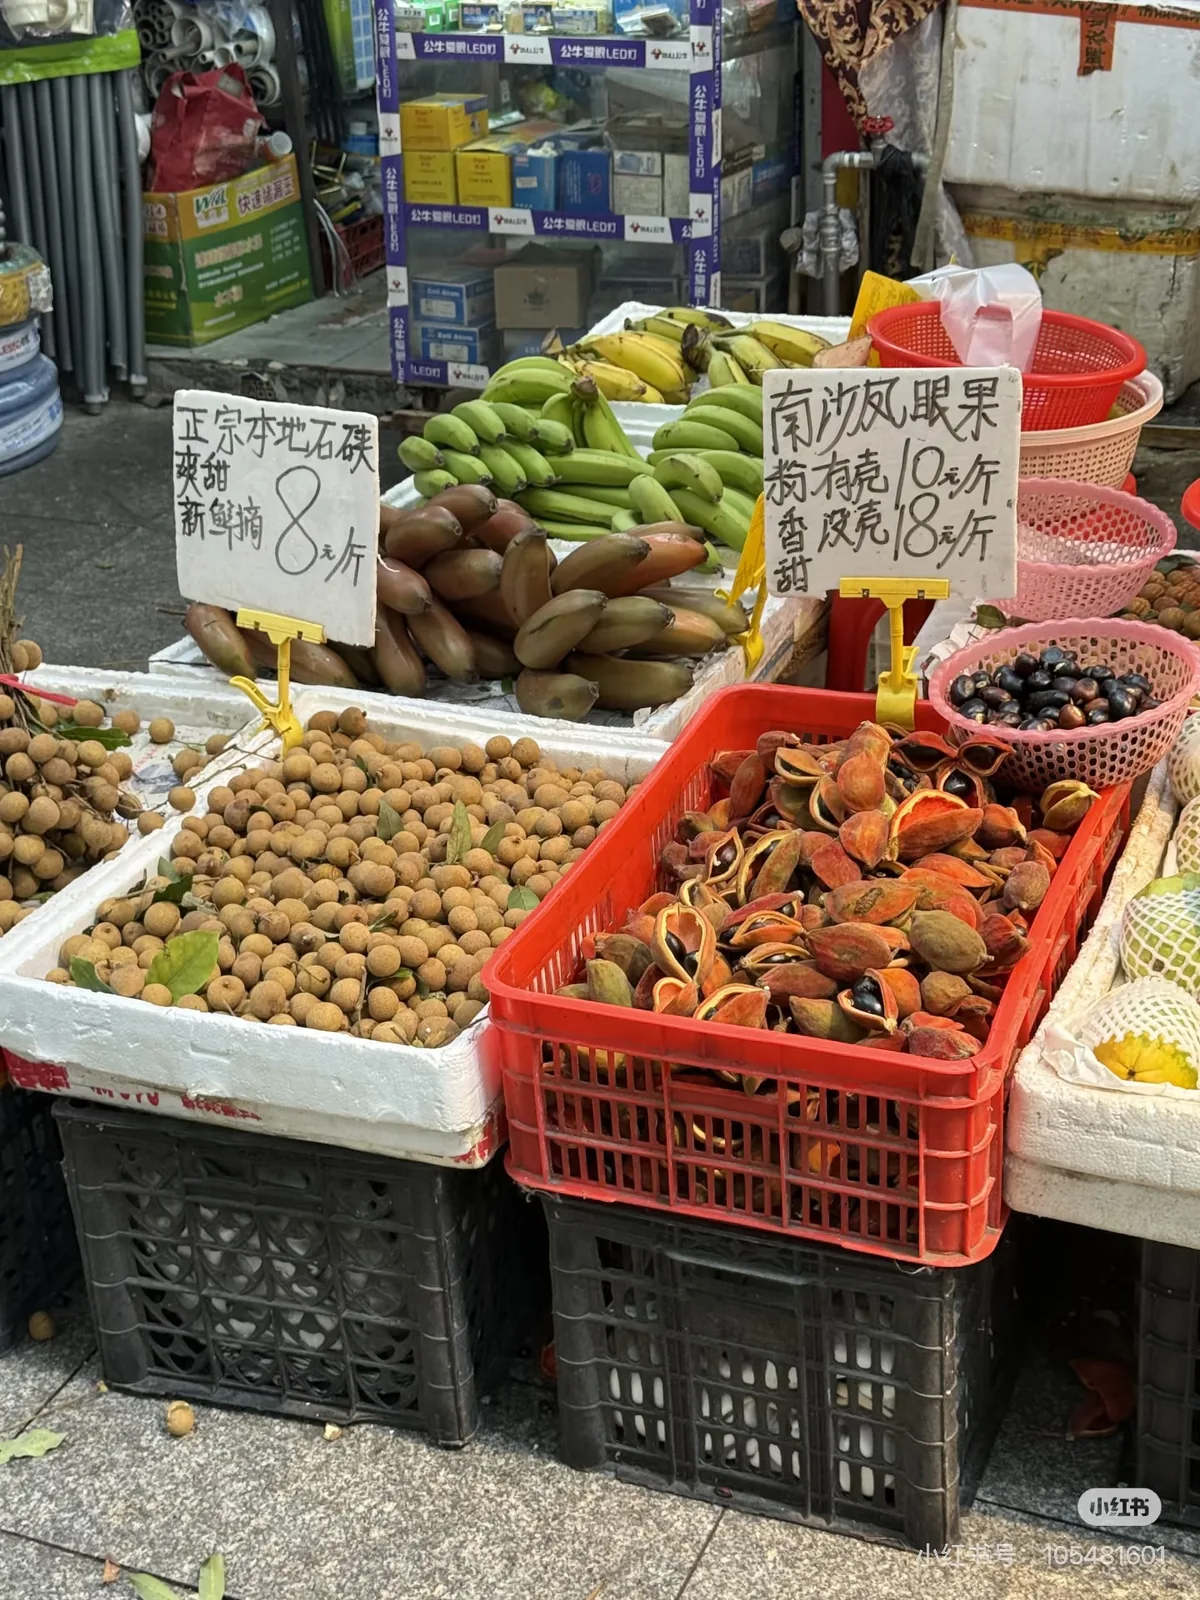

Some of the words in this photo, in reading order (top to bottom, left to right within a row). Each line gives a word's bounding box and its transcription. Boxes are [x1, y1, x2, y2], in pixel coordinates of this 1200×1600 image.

[770, 374, 1000, 456] 南沙凤眼果
[175, 444, 231, 498] 爽甜
